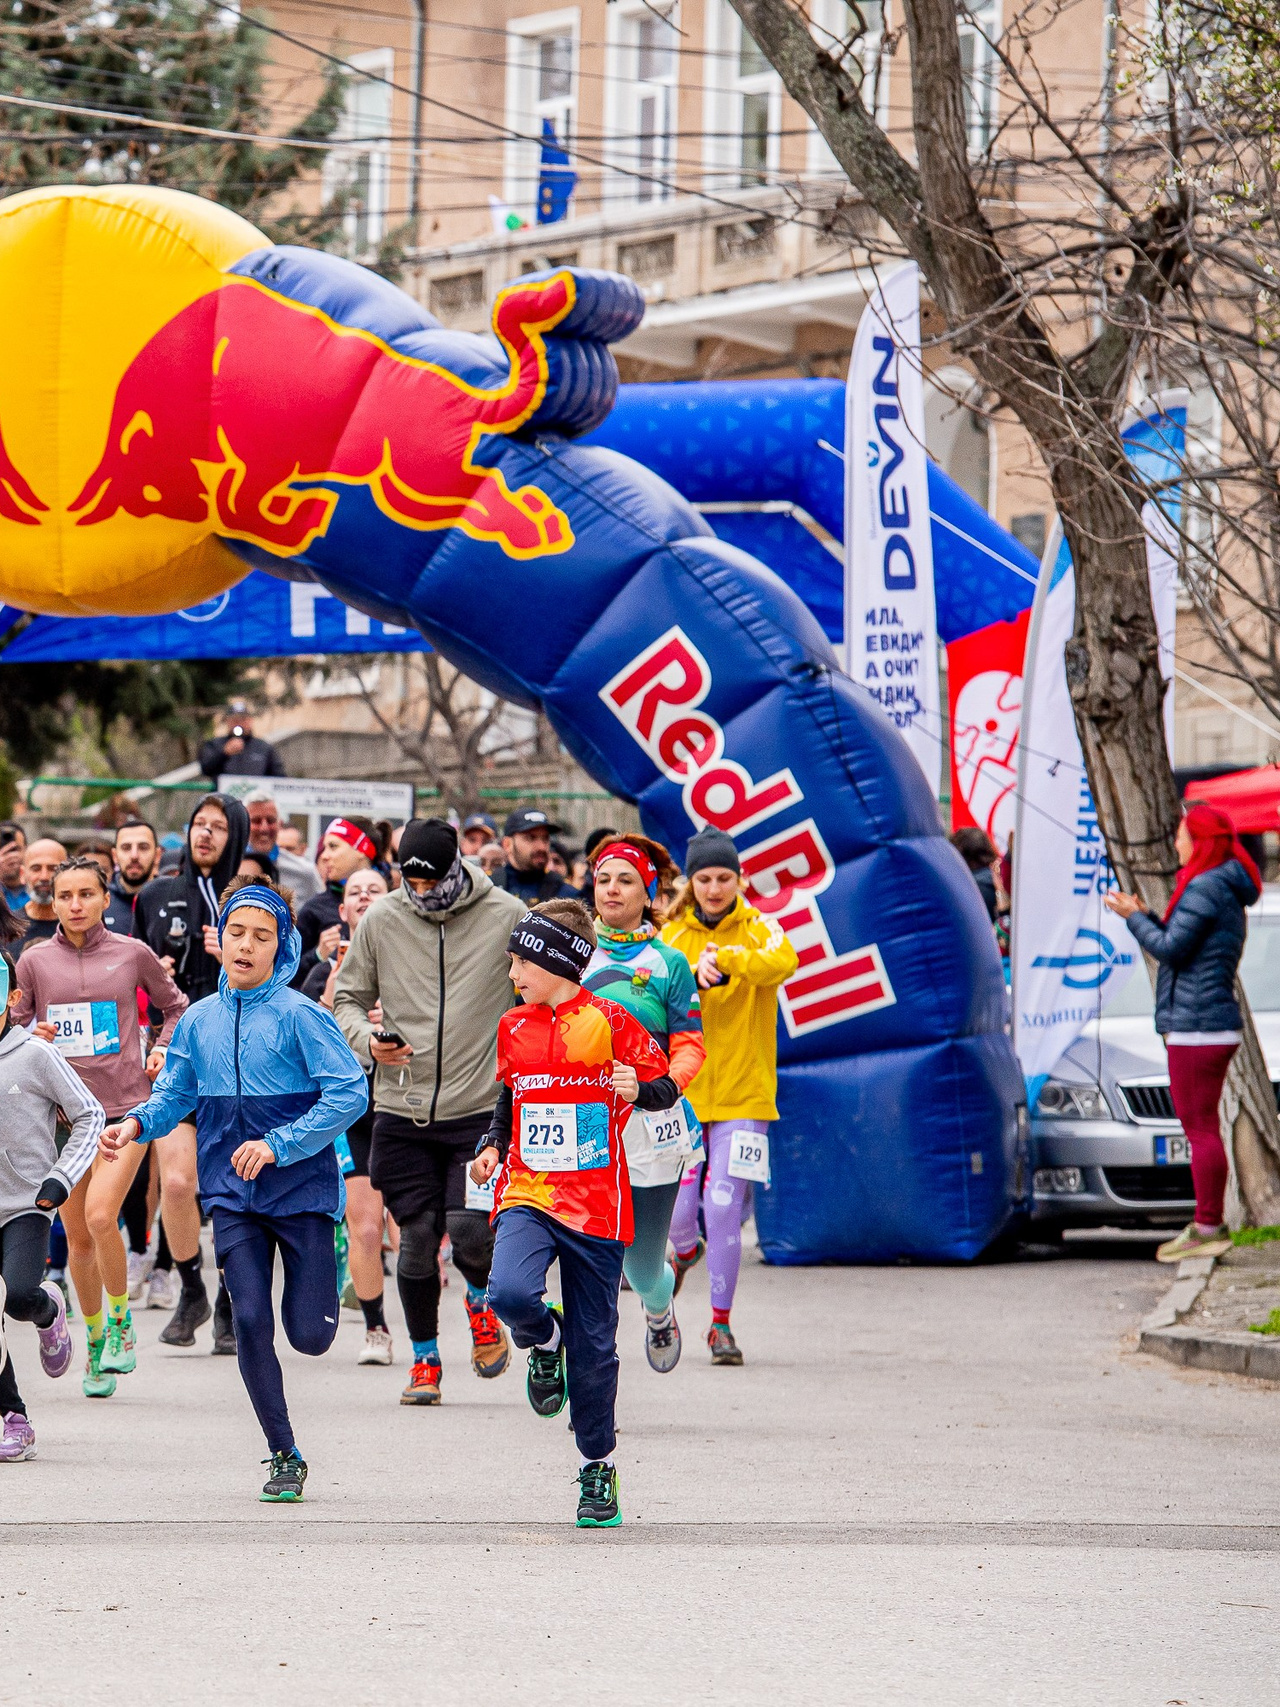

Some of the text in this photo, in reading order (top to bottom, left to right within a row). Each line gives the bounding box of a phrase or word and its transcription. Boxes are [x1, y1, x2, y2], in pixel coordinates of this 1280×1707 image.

[873, 336, 917, 590] DEVIN
[610, 637, 793, 834] Red
[519, 930, 546, 954] 100
[570, 935, 592, 958] 100
[53, 1019, 85, 1037] 284
[528, 1123, 565, 1146] 273
[655, 1119, 682, 1143] 223
[739, 1145, 762, 1162] 129
